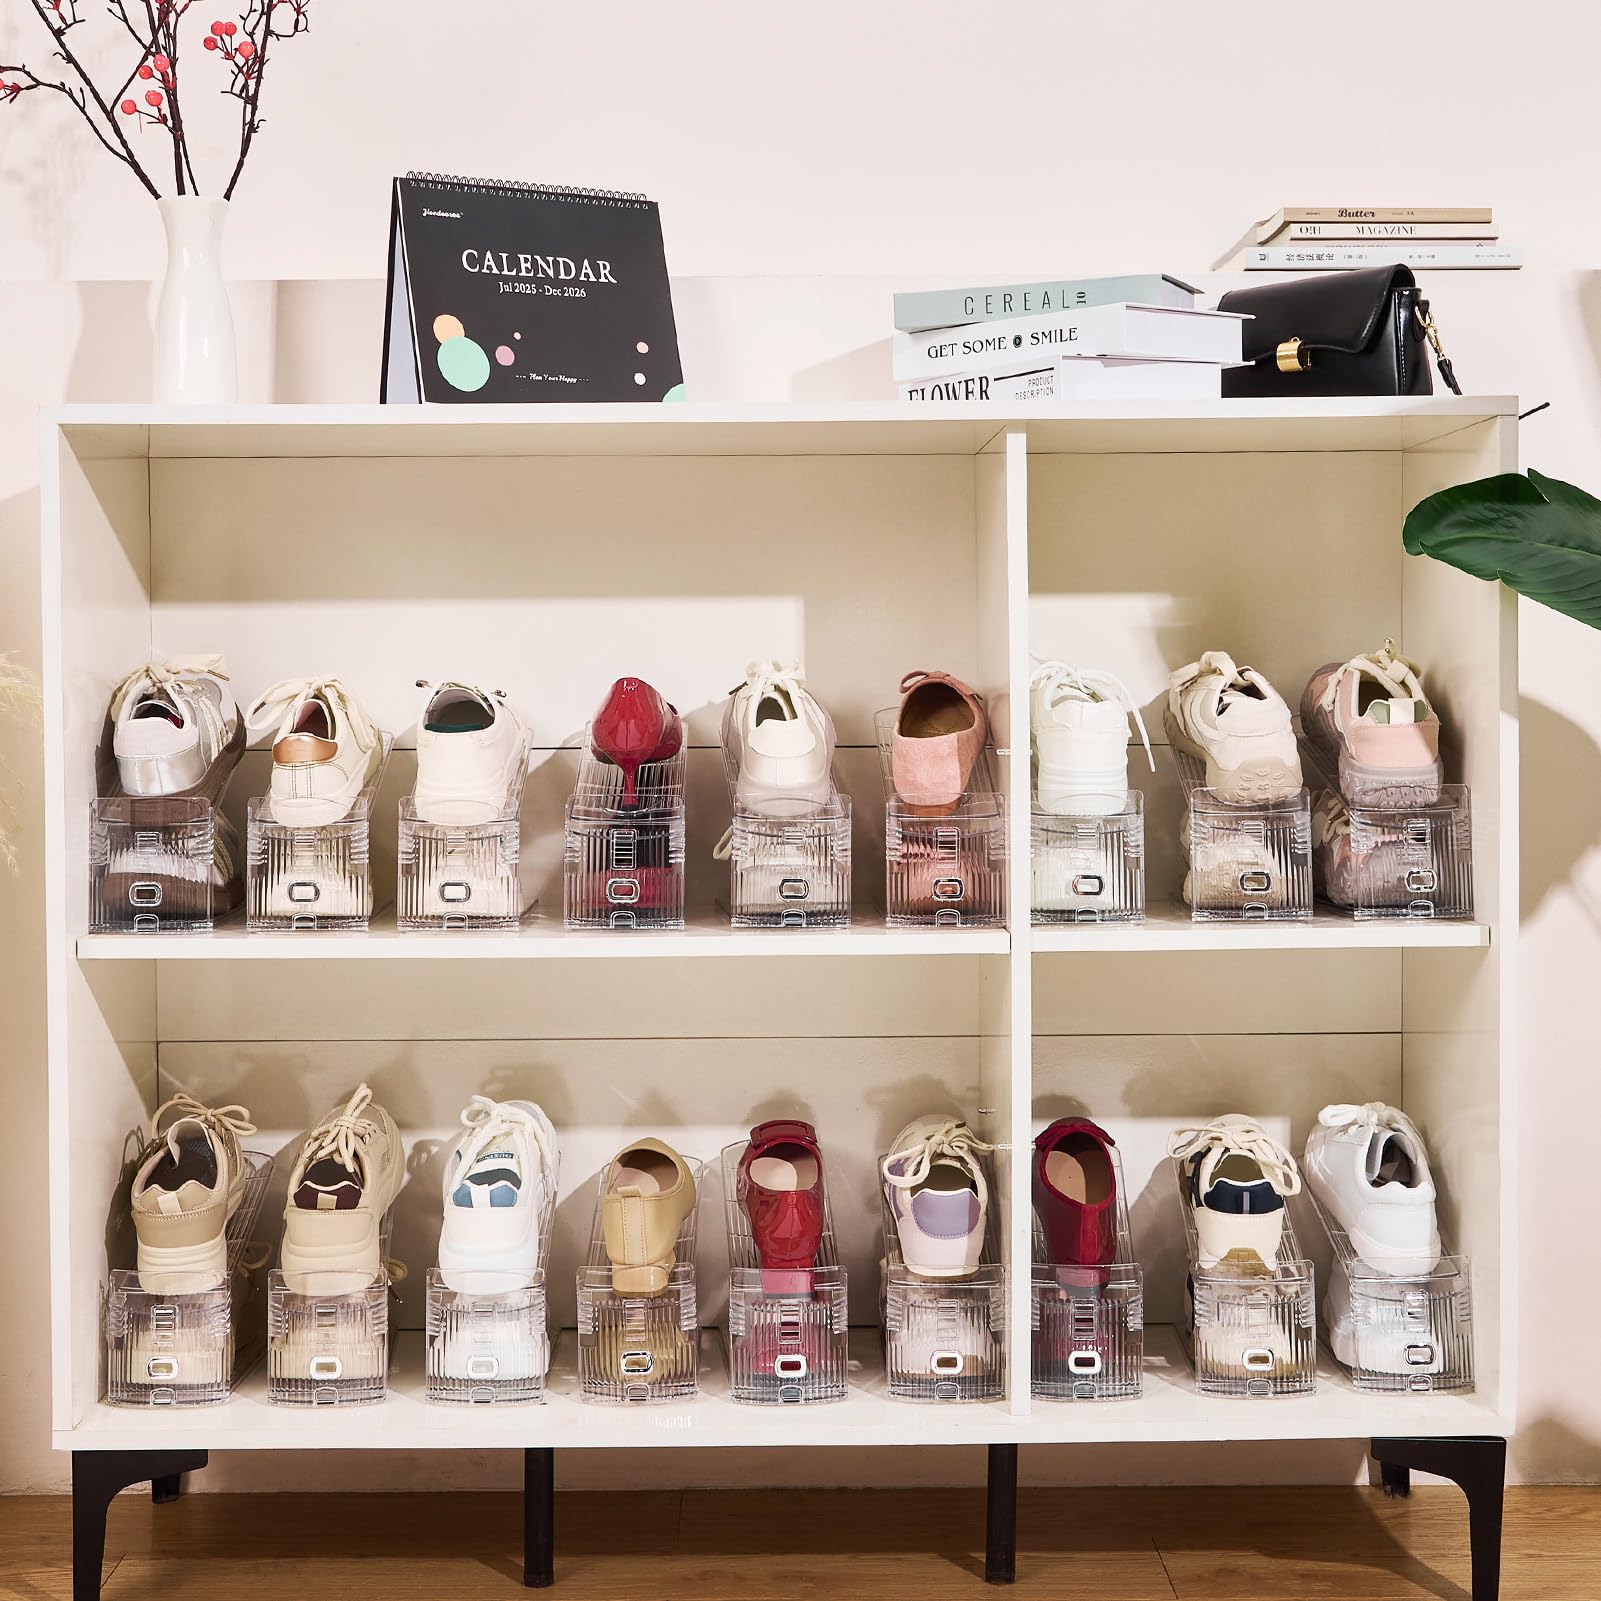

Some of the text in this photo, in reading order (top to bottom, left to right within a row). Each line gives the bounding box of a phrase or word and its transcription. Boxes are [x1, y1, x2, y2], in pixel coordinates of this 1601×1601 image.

[1338, 207, 1376, 218] Butter
[1355, 226, 1417, 235] MAGAZINE
[461, 249, 618, 284] CALENDAR
[498, 281, 513, 294] Jul
[514, 282, 537, 295] 2025
[544, 285, 562, 297] Dec
[563, 286, 587, 298] 2026
[964, 289, 1071, 315] CEREAL
[927, 327, 1079, 359] GET SOME SMILE
